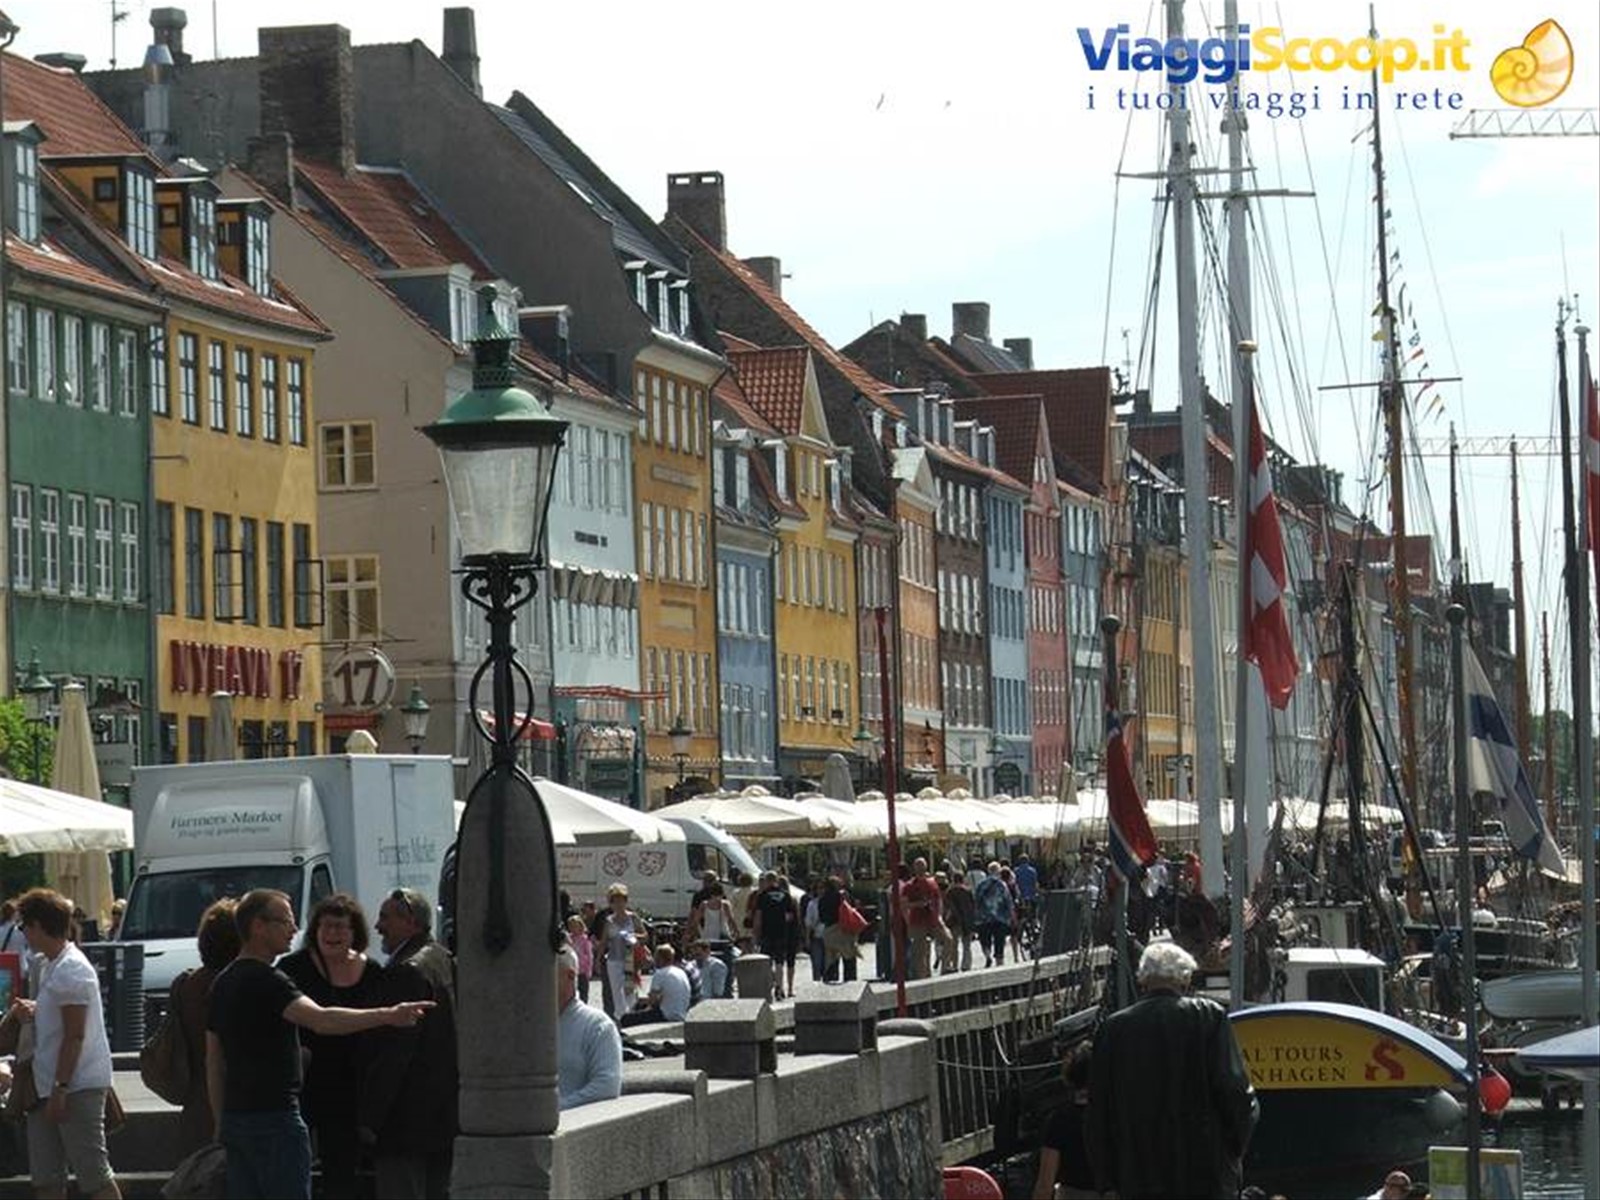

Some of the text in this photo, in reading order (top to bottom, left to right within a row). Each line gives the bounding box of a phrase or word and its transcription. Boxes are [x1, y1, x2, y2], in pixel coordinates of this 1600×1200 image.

[333, 659, 380, 707] 17
[232, 810, 282, 823] Market
[1270, 1045, 1344, 1063] TOURS
